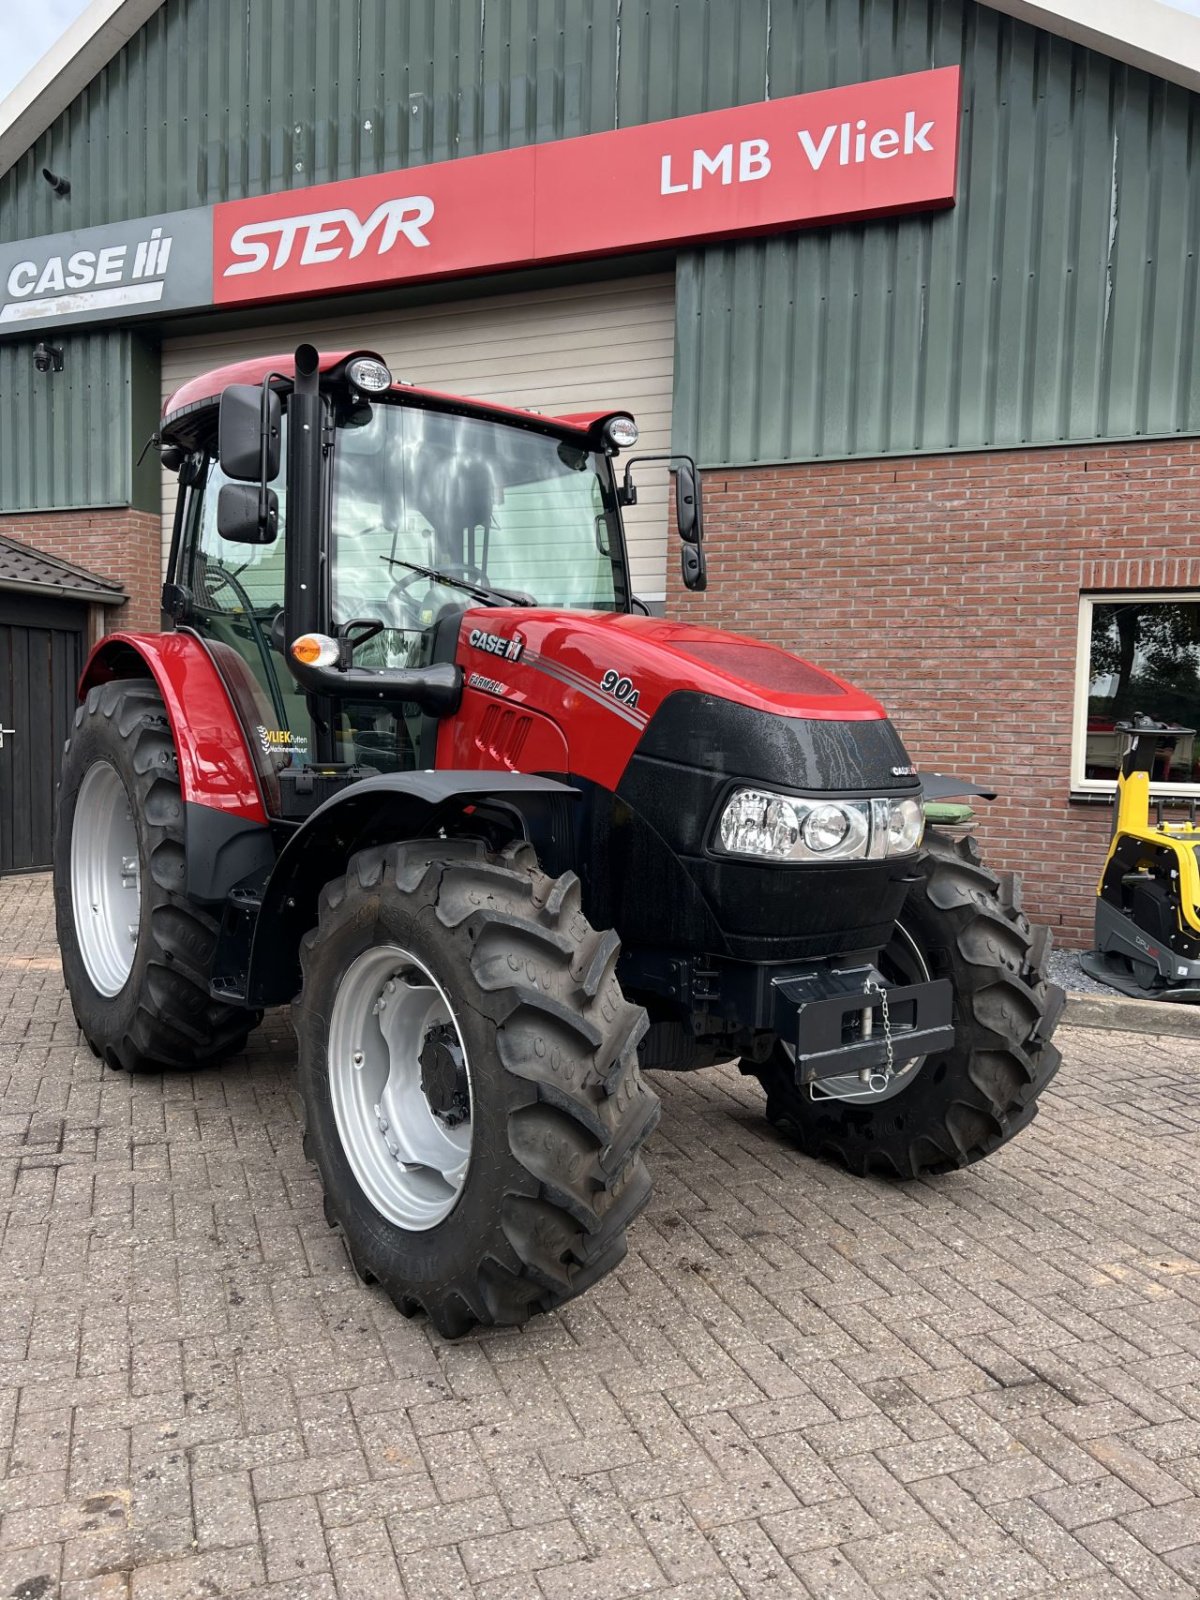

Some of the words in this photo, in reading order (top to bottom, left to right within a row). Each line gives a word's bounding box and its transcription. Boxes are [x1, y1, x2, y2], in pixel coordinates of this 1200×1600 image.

[660, 138, 771, 195] LMB
[797, 111, 934, 171] Vliek
[223, 195, 435, 277] STEYR
[7, 245, 127, 298] CASE
[469, 629, 507, 656] CASE
[468, 672, 508, 695] FARMALL
[600, 669, 640, 709] 90A
[266, 730, 291, 743] VLIEK
